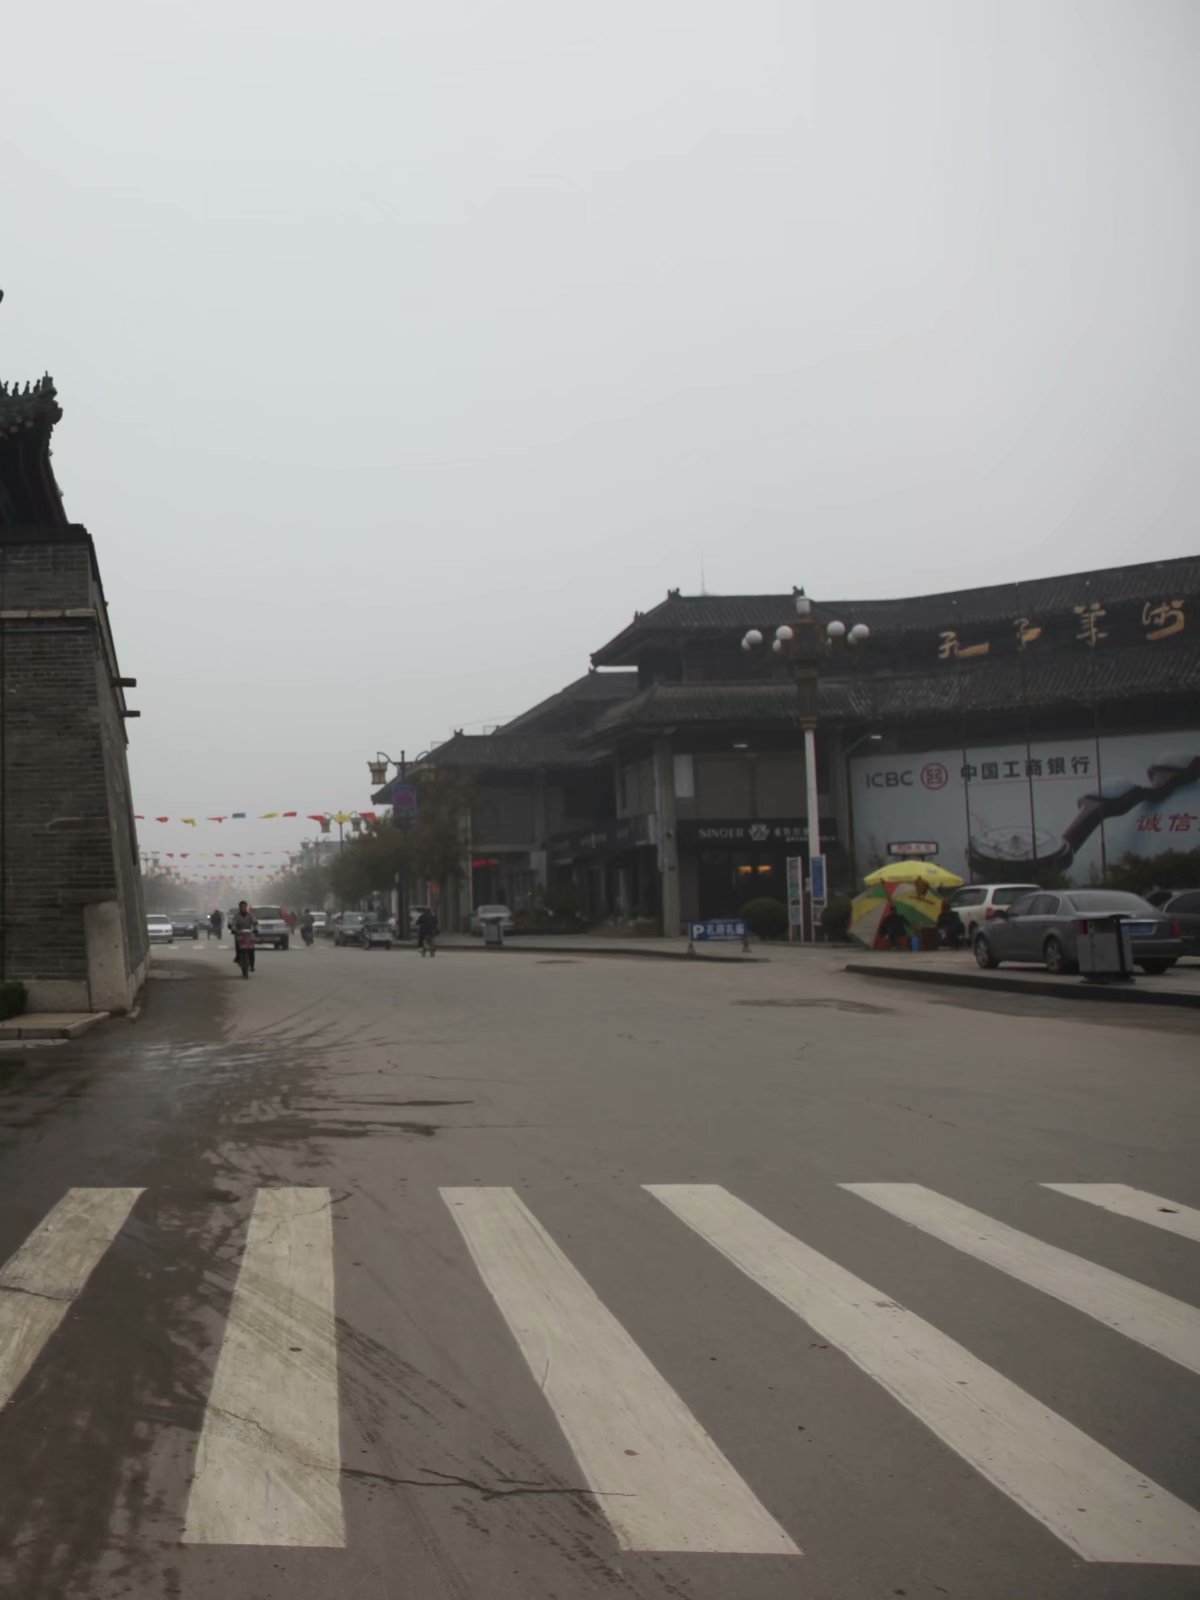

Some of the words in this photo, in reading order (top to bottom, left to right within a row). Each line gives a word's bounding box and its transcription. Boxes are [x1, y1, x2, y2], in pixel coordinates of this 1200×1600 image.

[960, 756, 1090, 782] 中国工商银行
[865, 770, 914, 789] ICBC
[1136, 812, 1200, 833] 诚信
[692, 924, 705, 940] P
